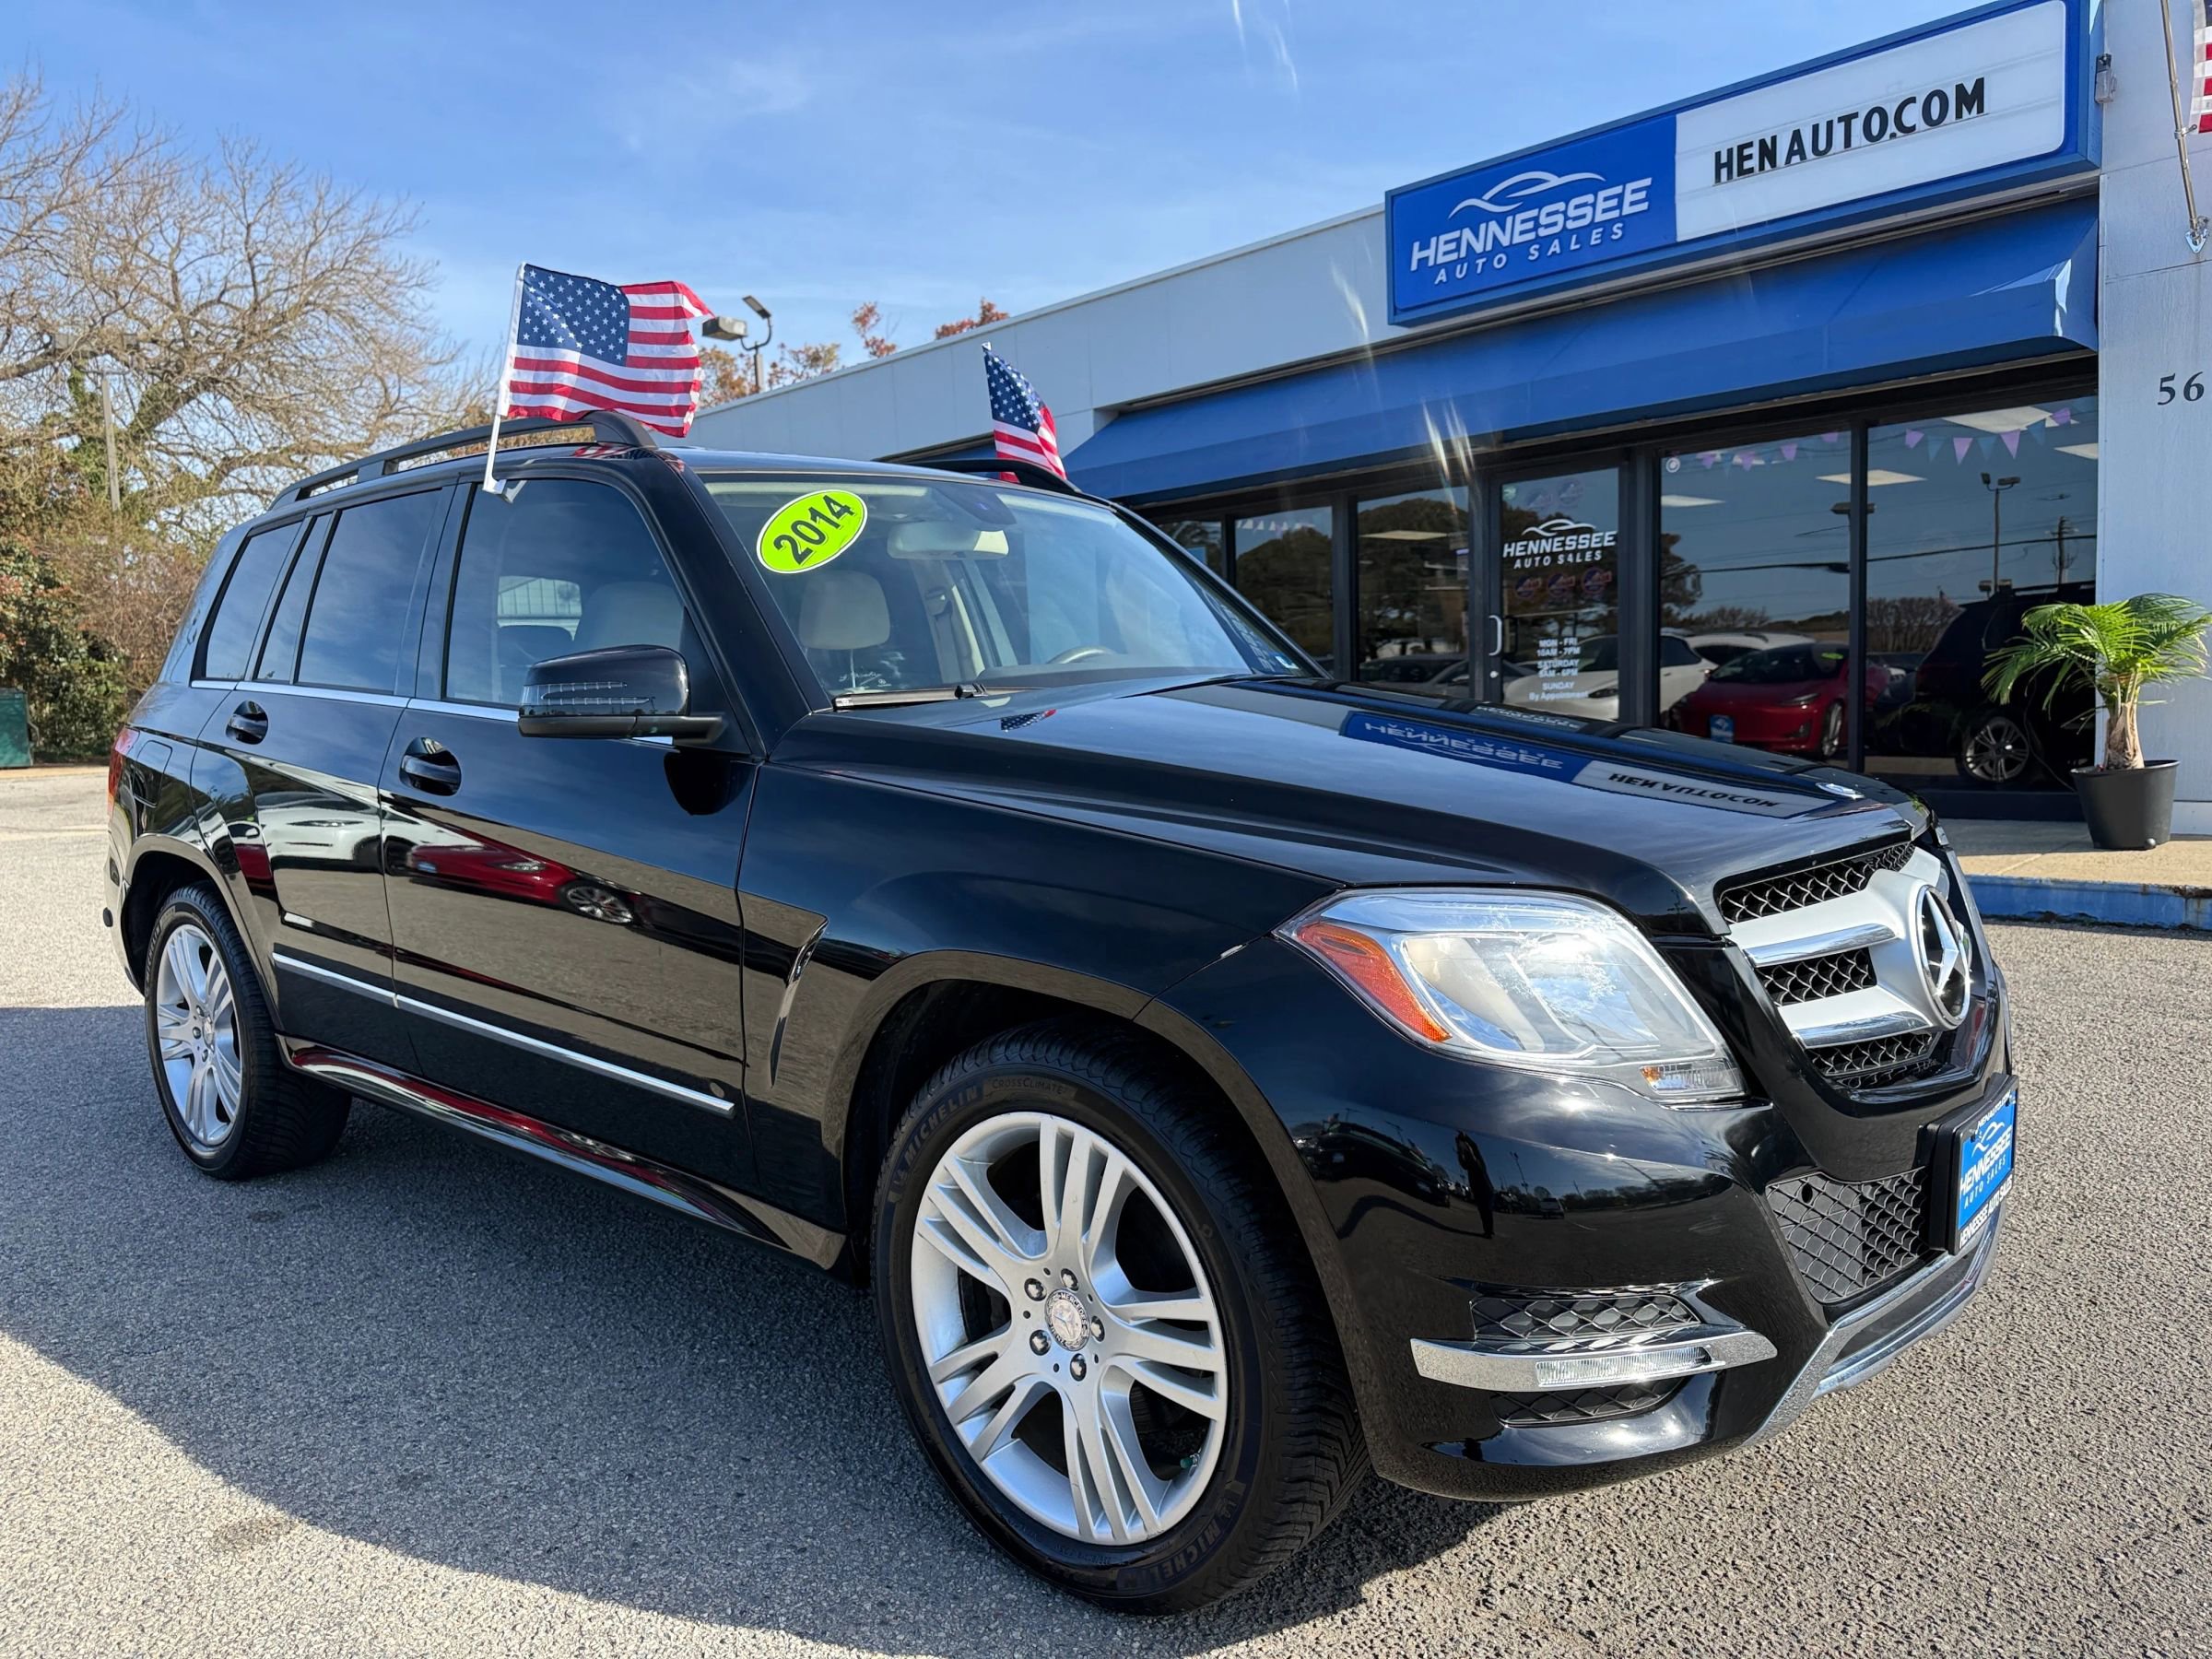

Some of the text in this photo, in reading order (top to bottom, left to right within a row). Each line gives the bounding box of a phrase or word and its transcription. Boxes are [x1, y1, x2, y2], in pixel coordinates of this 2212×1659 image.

[1410, 177, 1653, 272] HENNESSEE
[1434, 222, 1624, 285] AUTO SALES
[2157, 371, 2205, 406] 56
[772, 494, 855, 565] 2014
[1502, 530, 1618, 558] HENNESSEE
[1513, 550, 1602, 570] AUTO SALES
[1537, 659, 1580, 669] SATURDAY
[1542, 682, 1575, 690] SUNDAY
[904, 1086, 979, 1166] MICHELIN
[1959, 1125, 2013, 1196] HENNESSEE
[1964, 1154, 2006, 1209] AUTO SALES
